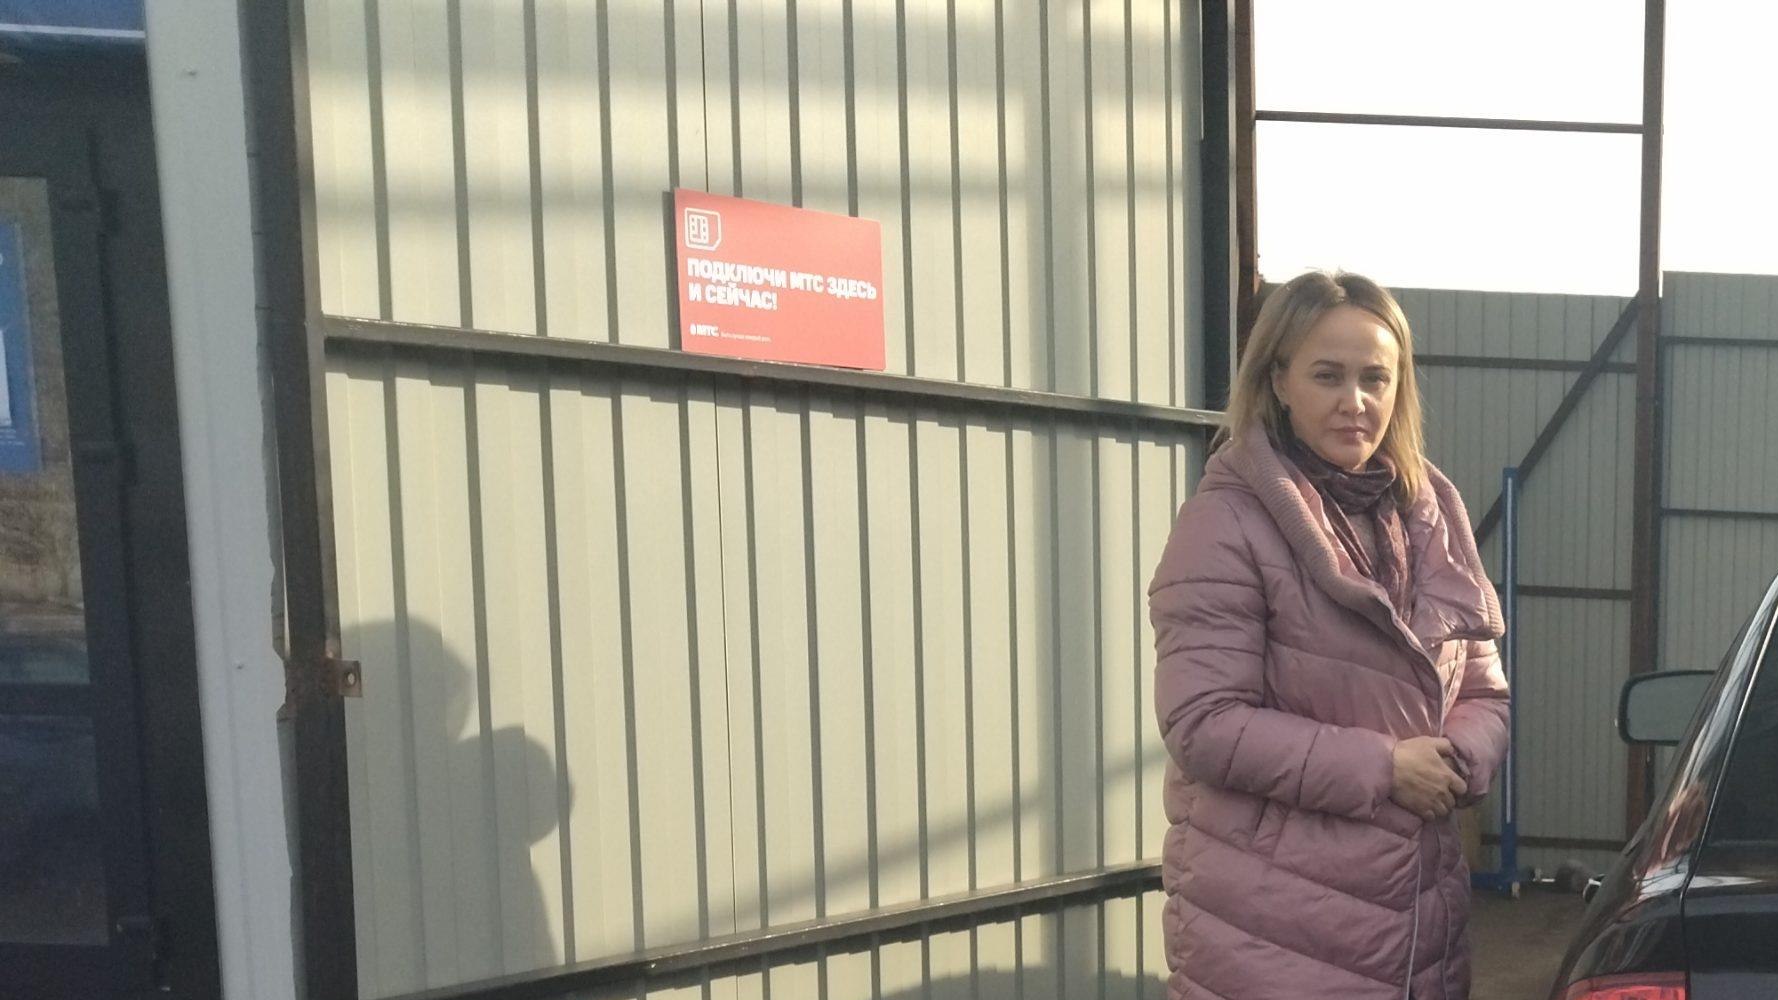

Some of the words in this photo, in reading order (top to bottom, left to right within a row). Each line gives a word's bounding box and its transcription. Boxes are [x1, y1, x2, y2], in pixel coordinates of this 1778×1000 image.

[687, 258, 787, 288] ПОДКЛЮЧИ
[790, 271, 824, 293] МТС
[827, 276, 877, 300] ЗДЕСЬ
[688, 282, 702, 302] И
[705, 283, 778, 311] СЕЙЧАС!
